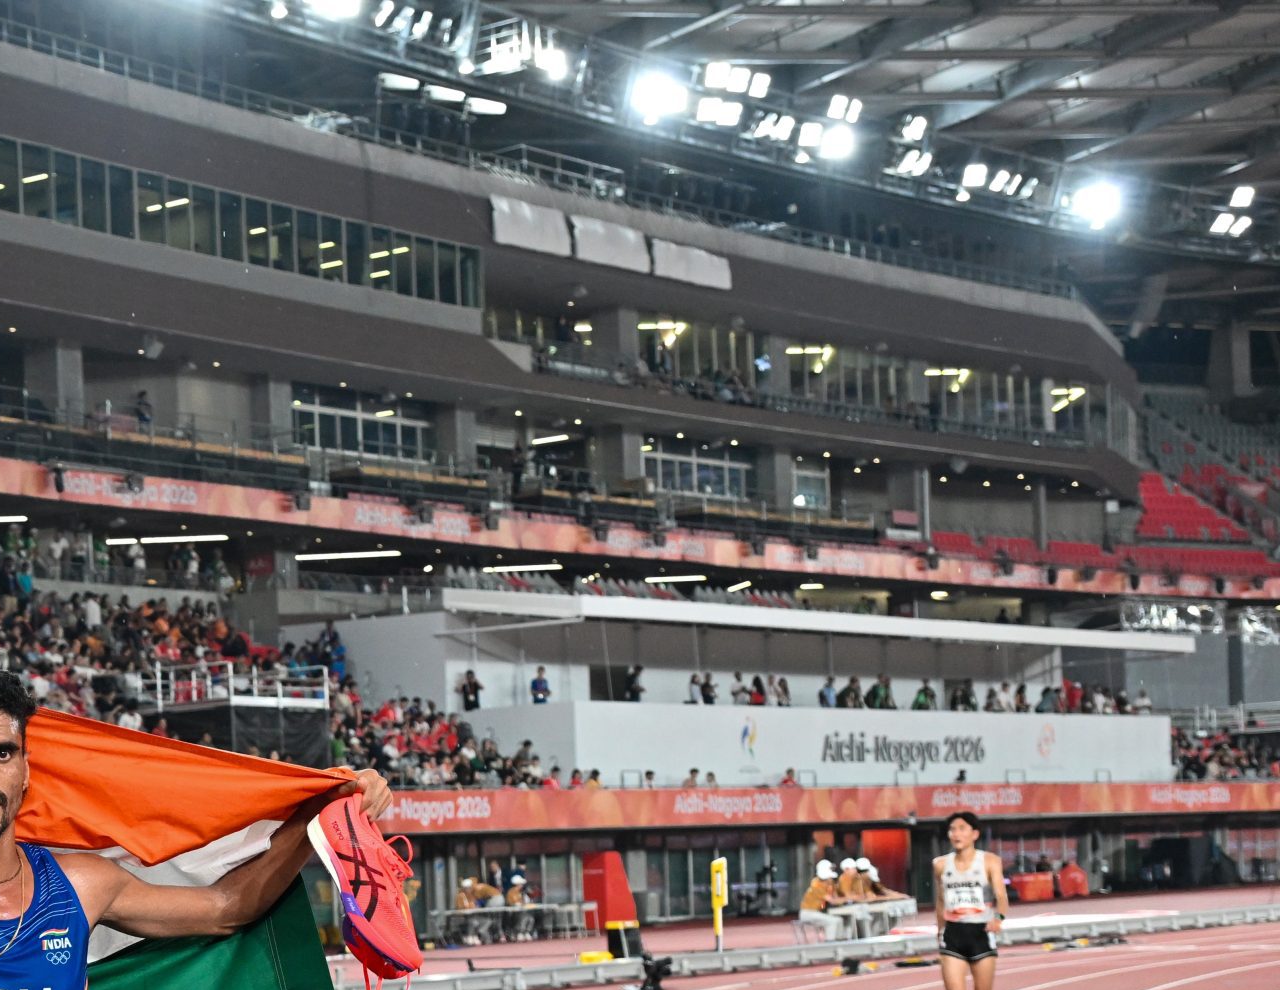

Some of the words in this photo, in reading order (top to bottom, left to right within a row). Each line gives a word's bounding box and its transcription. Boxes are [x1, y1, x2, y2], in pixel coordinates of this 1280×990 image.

[822, 731, 940, 771] Aichi-Nagoya
[943, 735, 985, 763] 2026
[456, 795, 491, 818] 2026
[331, 821, 344, 841] TOKYO
[41, 937, 72, 951] INDIA
